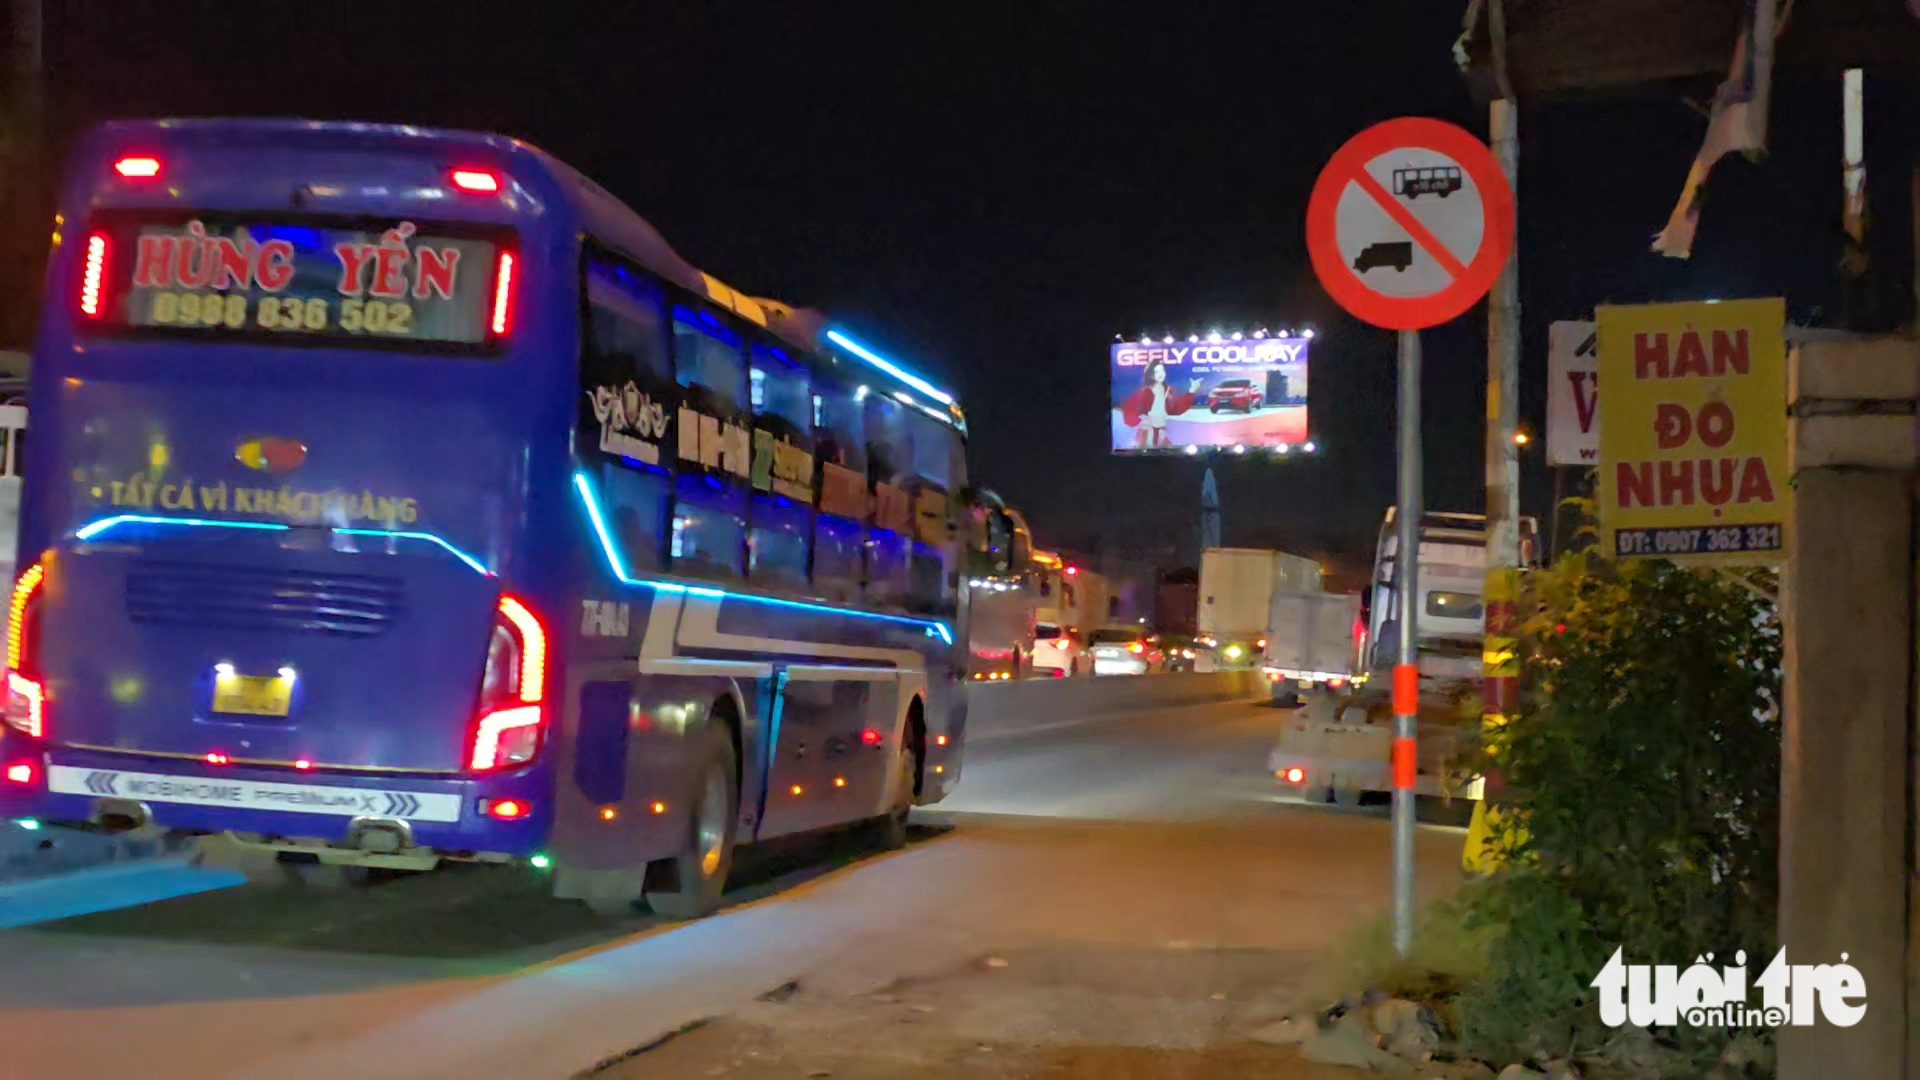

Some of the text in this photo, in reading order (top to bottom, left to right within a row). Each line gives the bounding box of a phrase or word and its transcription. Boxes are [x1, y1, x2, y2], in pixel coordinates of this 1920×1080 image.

[340, 299, 411, 334] 502
[1116, 344, 1303, 366] GEELY COOLRAY
[1706, 528, 1740, 549] 362
[1746, 526, 1778, 547] 321
